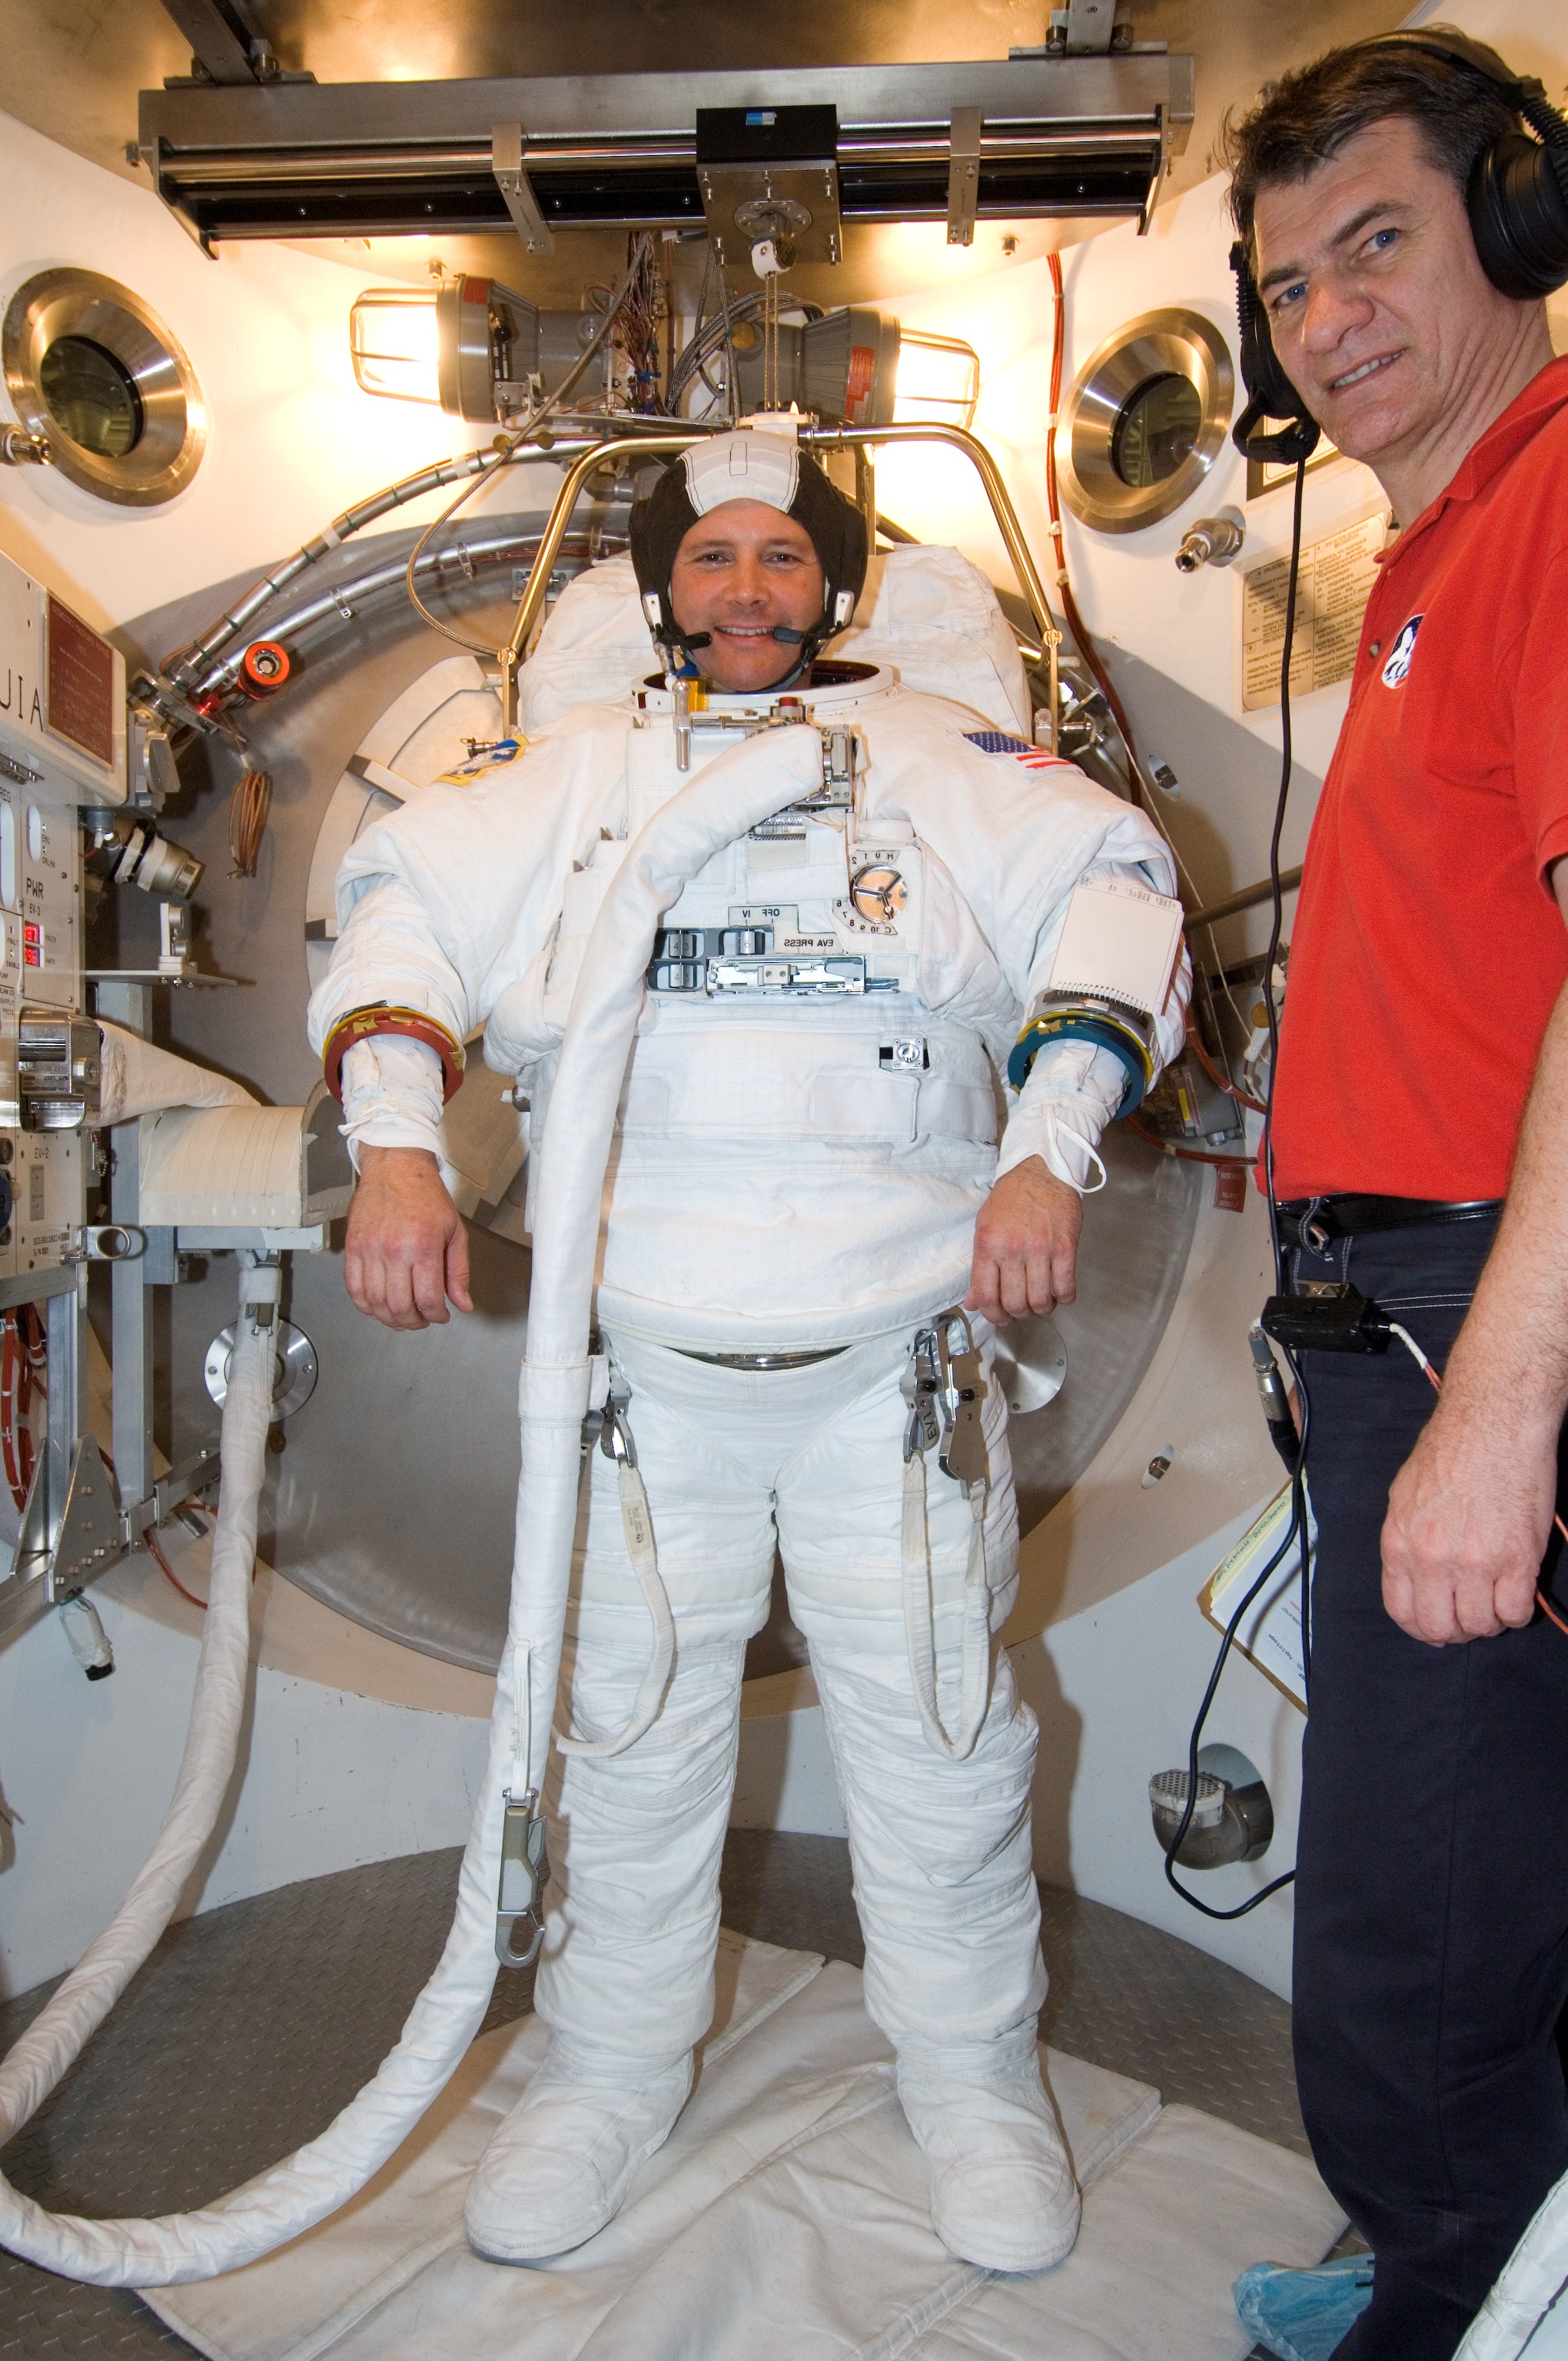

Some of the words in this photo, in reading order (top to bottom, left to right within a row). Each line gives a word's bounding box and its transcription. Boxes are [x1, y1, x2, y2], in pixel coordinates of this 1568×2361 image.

[26, 878, 44, 899] PWR
[29, 903, 41, 916] EV-2
[34, 1147, 49, 1159] EV-2
